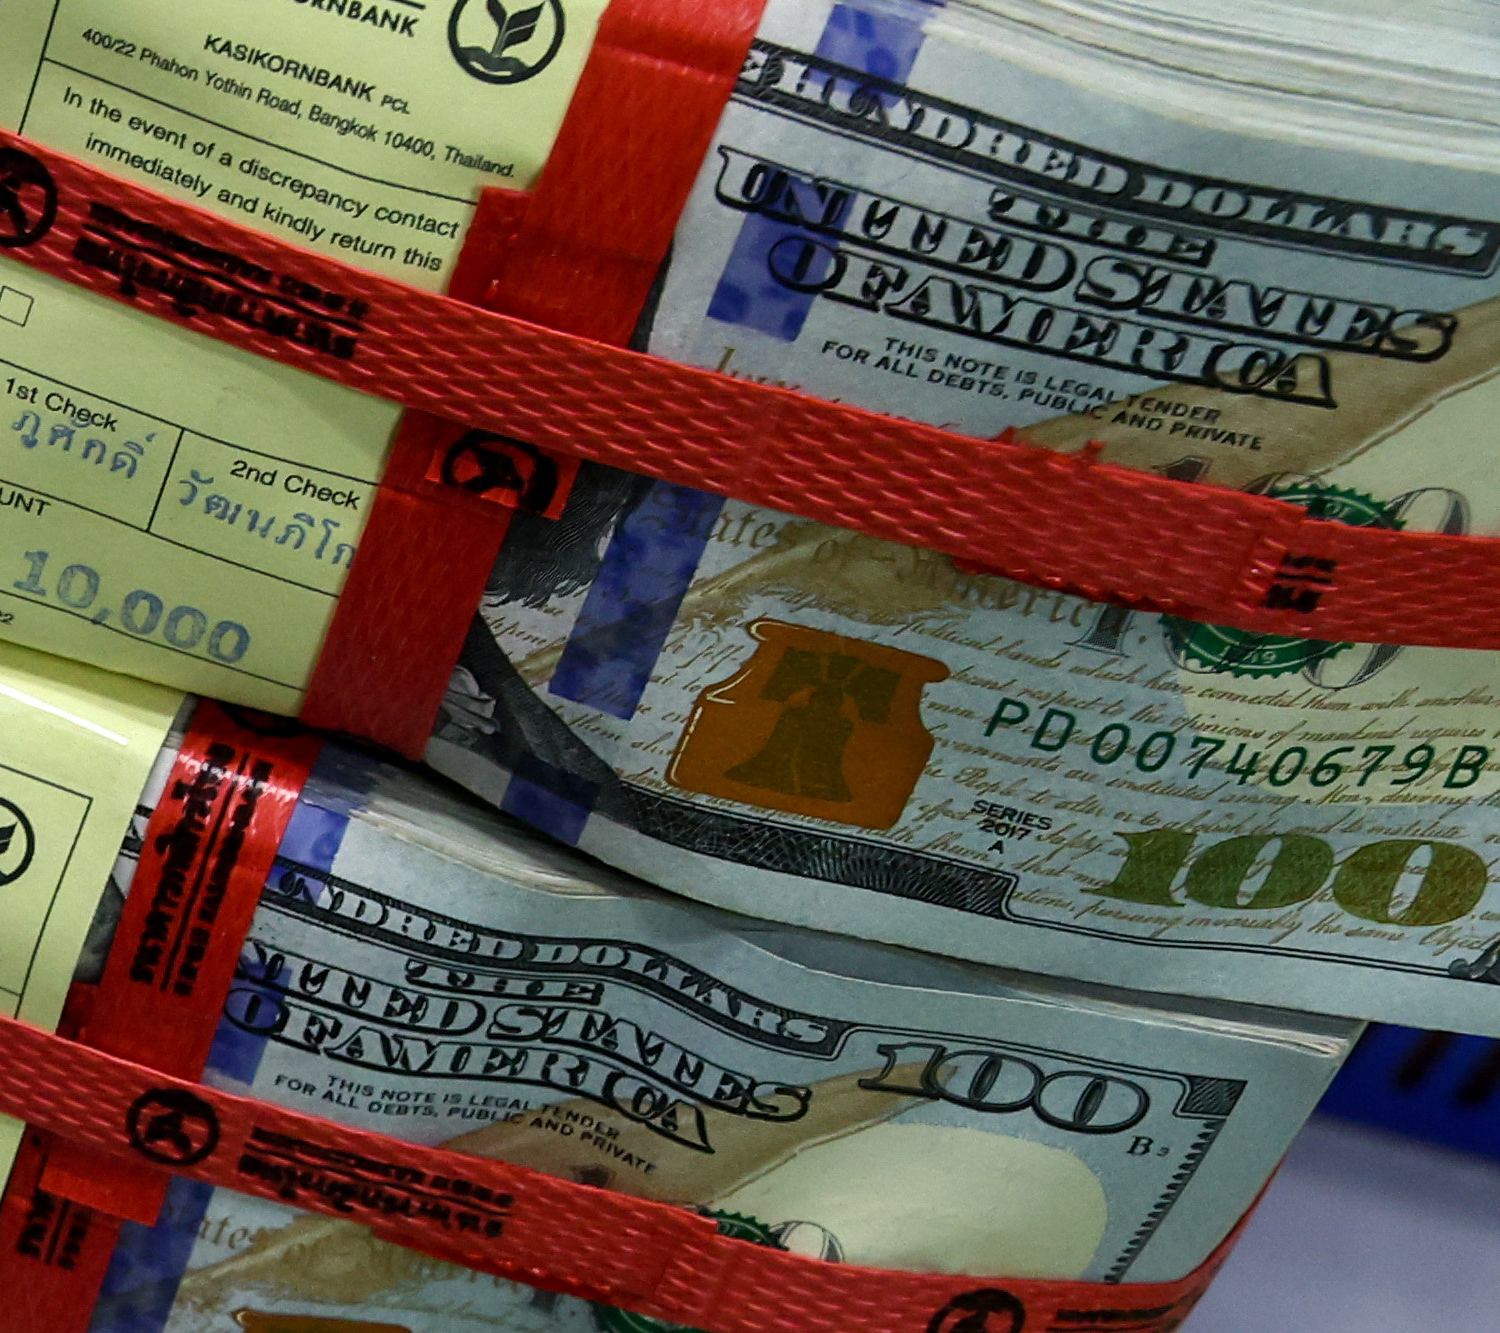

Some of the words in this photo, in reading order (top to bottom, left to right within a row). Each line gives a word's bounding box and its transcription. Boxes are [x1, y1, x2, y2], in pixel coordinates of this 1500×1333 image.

[81, 28, 136, 58] 400/22
[139, 51, 199, 81] Phahon
[204, 70, 252, 100] Yothin
[256, 88, 302, 119] Road,
[307, 105, 378, 142] Bangkok
[383, 130, 436, 161] 10400,
[444, 145, 515, 178] Thailand.
[203, 34, 377, 102] KASIKORNBANK
[381, 94, 410, 114] PCL
[63, 87, 82, 108] In
[91, 97, 122, 123] the
[128, 113, 187, 149] event
[192, 139, 217, 158] of
[219, 150, 233, 167] a
[238, 157, 368, 219] discrepancy
[373, 205, 461, 240] contact
[85, 133, 213, 197] immediately
[217, 187, 258, 214] and
[262, 205, 326, 242] kindly
[329, 230, 396, 261] return
[402, 248, 443, 273] this
[781, 62, 1134, 198] HUNDRED
[1138, 173, 1492, 261] DOLLARS
[714, 145, 1080, 295] UNITED
[1075, 252, 1459, 362] STATES
[885, 337, 939, 364] THIS
[945, 354, 1007, 382] NOTE
[1013, 368, 1038, 385] IS
[1043, 375, 1117, 403] LEGAL
[1127, 396, 1222, 425] TENDER
[886, 273, 1339, 409] AMERICA
[5, 377, 38, 404] 1st
[44, 393, 118, 432] Check
[821, 341, 869, 364] FOR
[874, 357, 919, 378] ALL
[1015, 389, 1103, 421] PUBLIC
[1111, 411, 1163, 431] AND
[1169, 420, 1266, 451] PRIVATE
[229, 460, 278, 488] 2nd
[283, 475, 361, 510] Check
[12, 550, 252, 664] 10,000
[982, 697, 1495, 791] PD00740679B
[970, 799, 1055, 830] SERIES
[979, 819, 1034, 841] 2017
[986, 836, 1006, 855] A
[1080, 828, 1488, 926] 100
[532, 938, 832, 1046] DOLLARS
[325, 1021, 715, 1153] AMERICA
[326, 1075, 375, 1097] THIS
[380, 1089, 432, 1103] NOTE
[442, 1094, 463, 1105] IS
[468, 1095, 531, 1111] LEGAL
[540, 1103, 621, 1140] TENDER
[488, 1000, 812, 1122] STATES
[858, 1042, 1151, 1134] 100
[274, 1074, 318, 1096] FOR
[322, 1087, 360, 1109] ALL
[446, 1106, 524, 1124] PUBLIC
[528, 1116, 575, 1137] AND
[579, 1131, 659, 1175] PRIVATE
